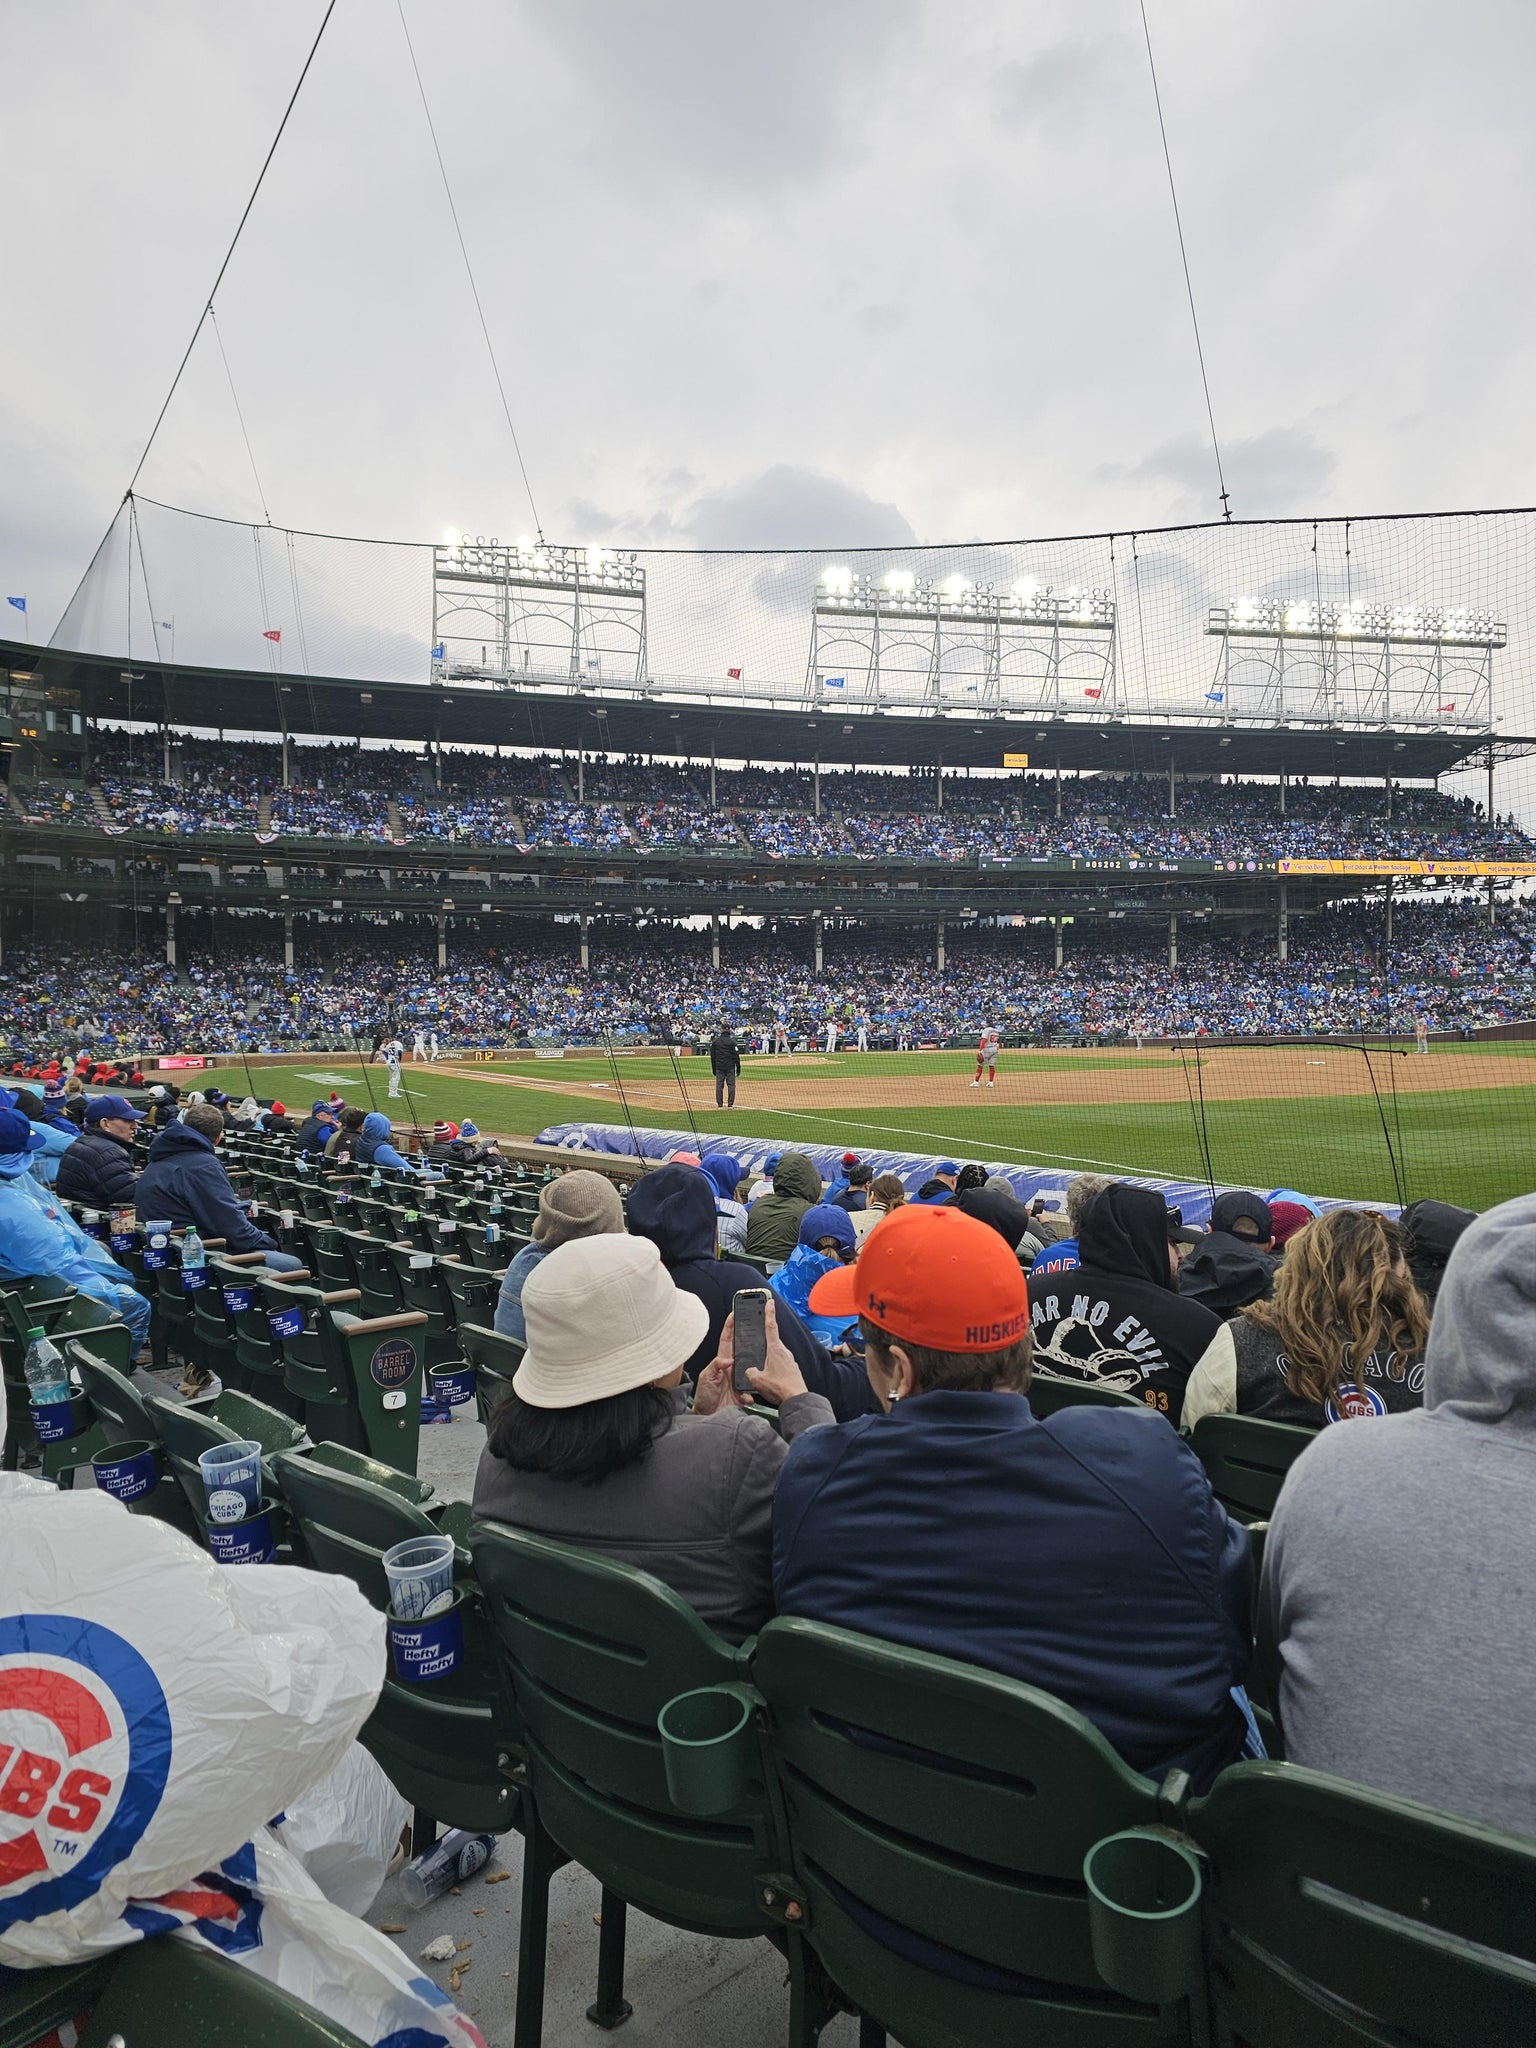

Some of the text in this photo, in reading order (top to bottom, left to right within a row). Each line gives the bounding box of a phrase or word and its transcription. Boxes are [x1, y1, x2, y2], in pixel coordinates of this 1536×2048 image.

[966, 1313, 1026, 1344] HUSKIES
[1071, 1294, 1109, 1326] NO
[1112, 1315, 1169, 1378] EVIL
[378, 1354, 410, 1370] BARREL
[382, 1366, 406, 1379] ROOM
[391, 1395, 398, 1406] 7
[1145, 1389, 1169, 1411] 93
[42, 1429, 63, 1438] Hefty
[108, 1476, 133, 1488] Hefty
[121, 1481, 145, 1496] Hefty
[211, 1501, 243, 1512] CHICAGO
[220, 1546, 248, 1558] Hefty
[393, 1632, 419, 1646] Hefty
[406, 1647, 437, 1659] Hefty
[422, 1656, 453, 1674] Hefty
[53, 1839, 78, 1856] TM
